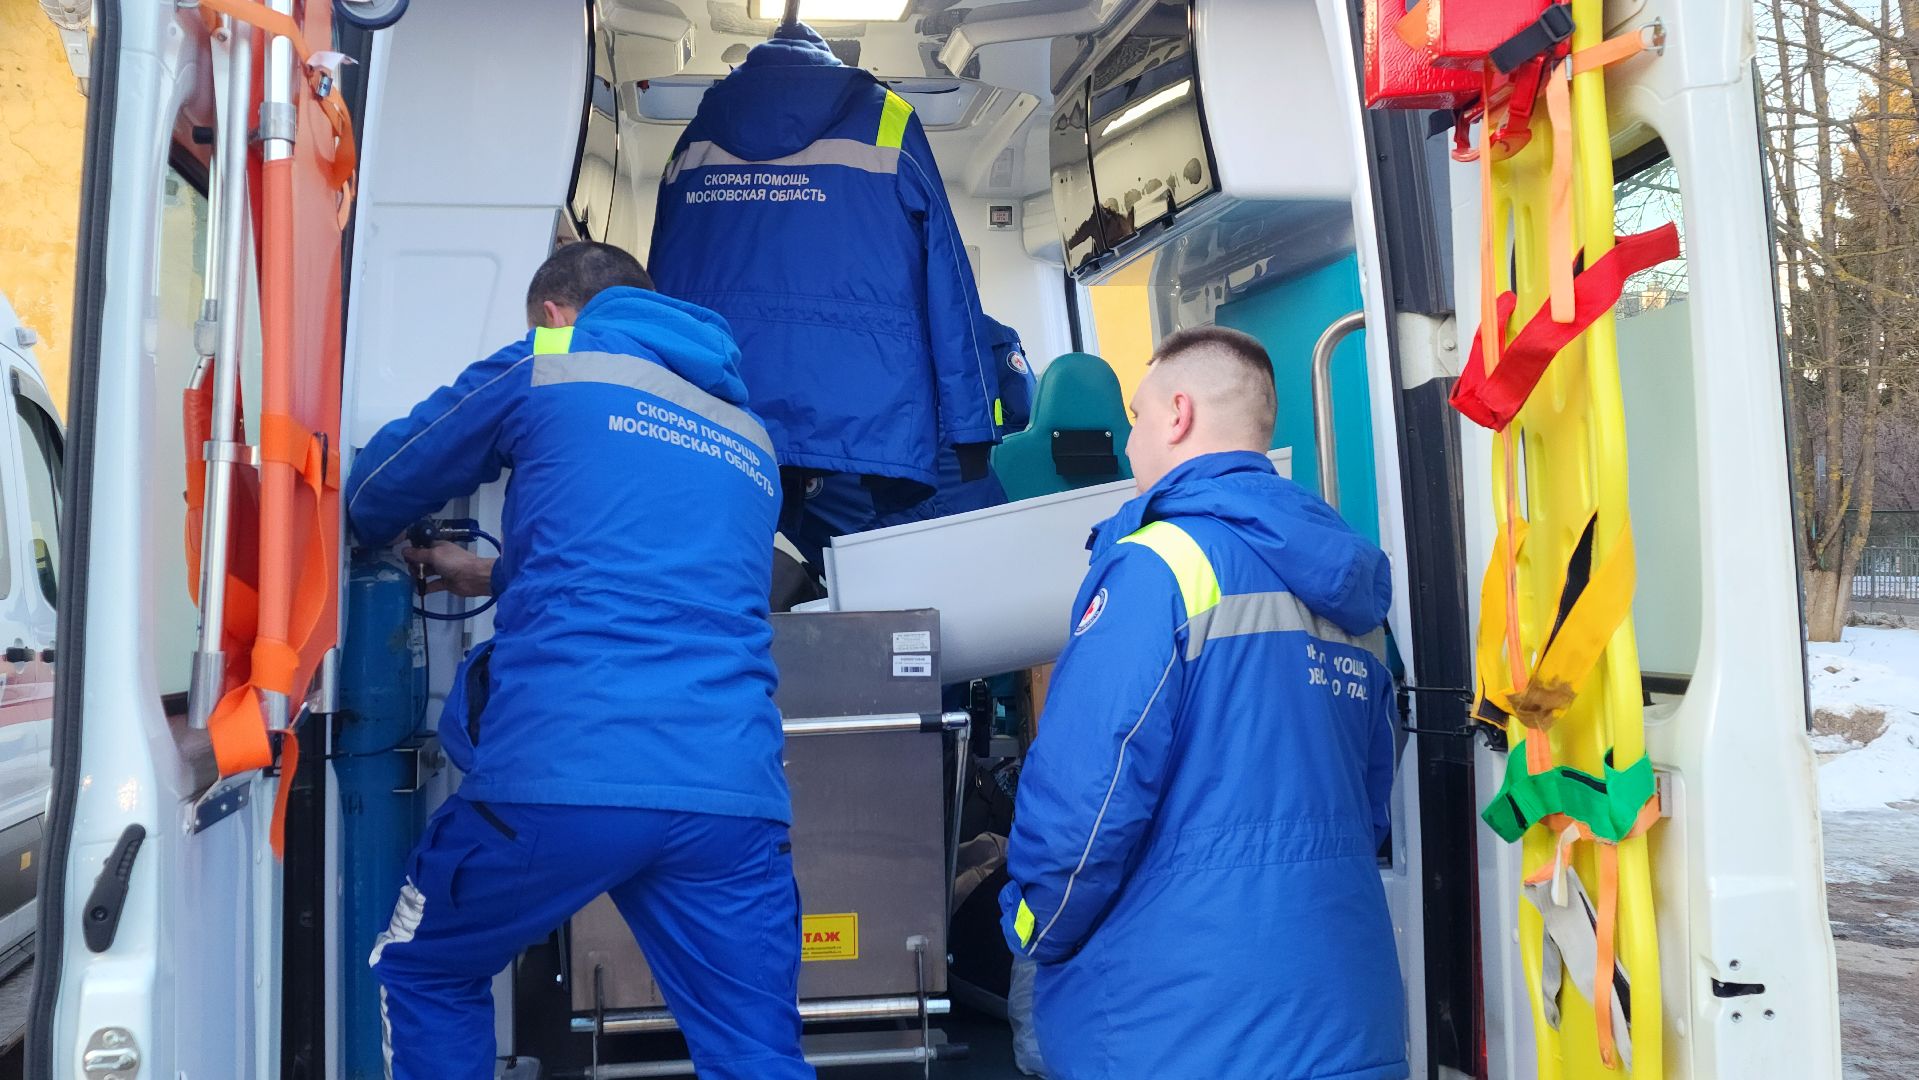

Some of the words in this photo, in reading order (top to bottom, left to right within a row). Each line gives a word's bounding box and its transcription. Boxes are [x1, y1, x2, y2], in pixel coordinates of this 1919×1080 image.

[704, 173, 751, 186] СКОРАЯ
[753, 173, 810, 187] ПОМОЩЬ
[686, 189, 767, 204] МОСКОВСКАЯ
[769, 188, 827, 202] ОБЛАСТЬ
[636, 401, 698, 434] СКОРАЯ
[700, 425, 761, 467] ПОМОЩЬ
[608, 415, 722, 459] МОСКОВСКАЯ
[724, 450, 774, 497] ОБЛАСТЬ
[803, 931, 841, 943] ТАЖ
